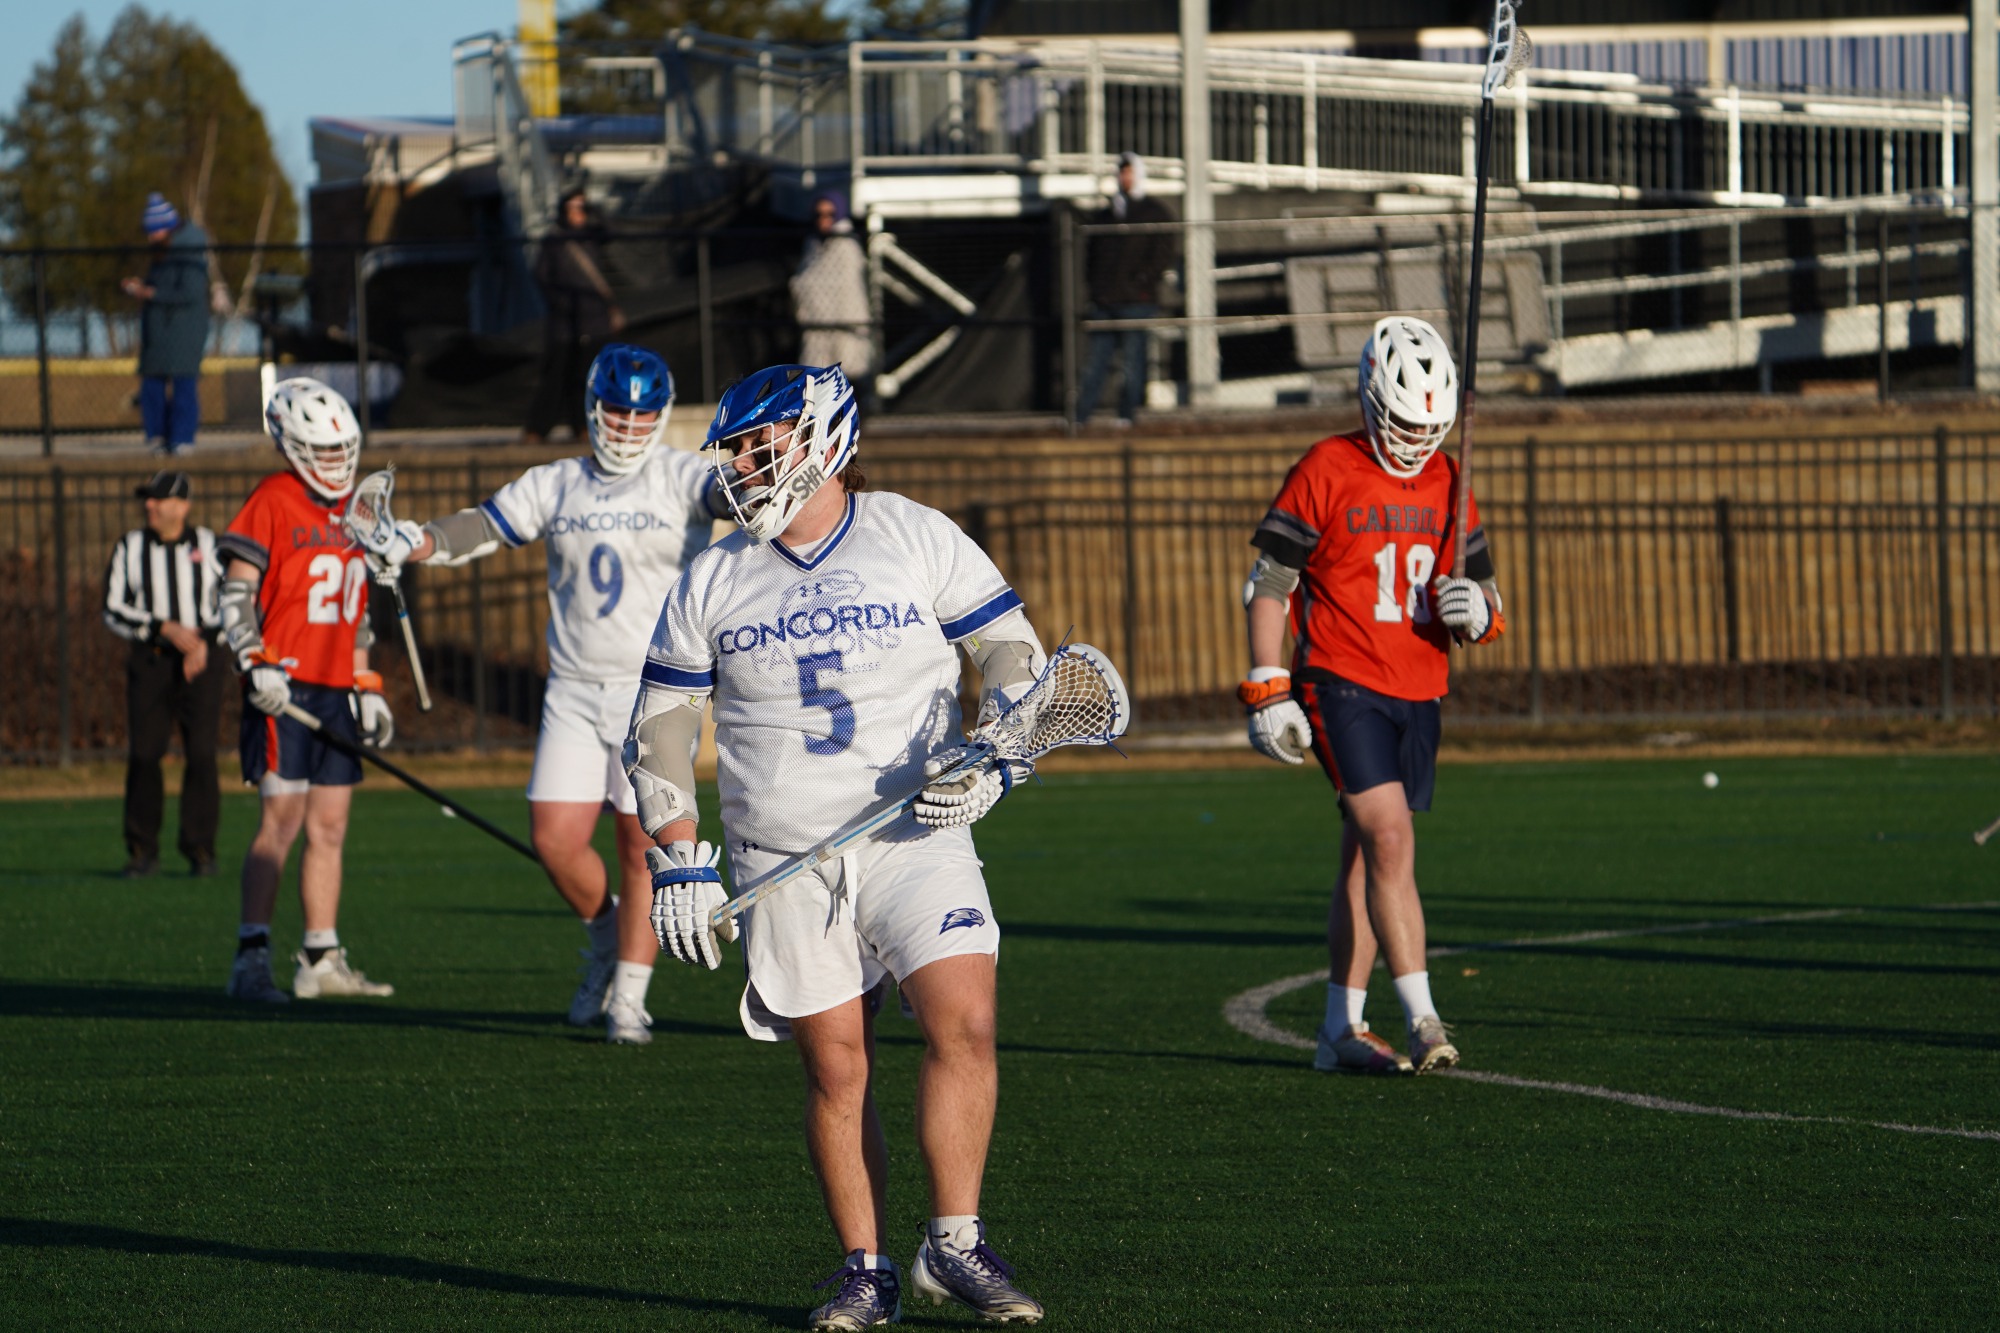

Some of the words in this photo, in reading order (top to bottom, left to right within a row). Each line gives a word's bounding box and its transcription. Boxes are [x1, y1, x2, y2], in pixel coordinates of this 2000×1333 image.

[792, 464, 825, 500] SHA
[307, 554, 367, 625] 20
[588, 542, 624, 619] 9
[1373, 542, 1436, 624] 18
[718, 602, 925, 655] CONCORDIA
[797, 650, 857, 756] 5
